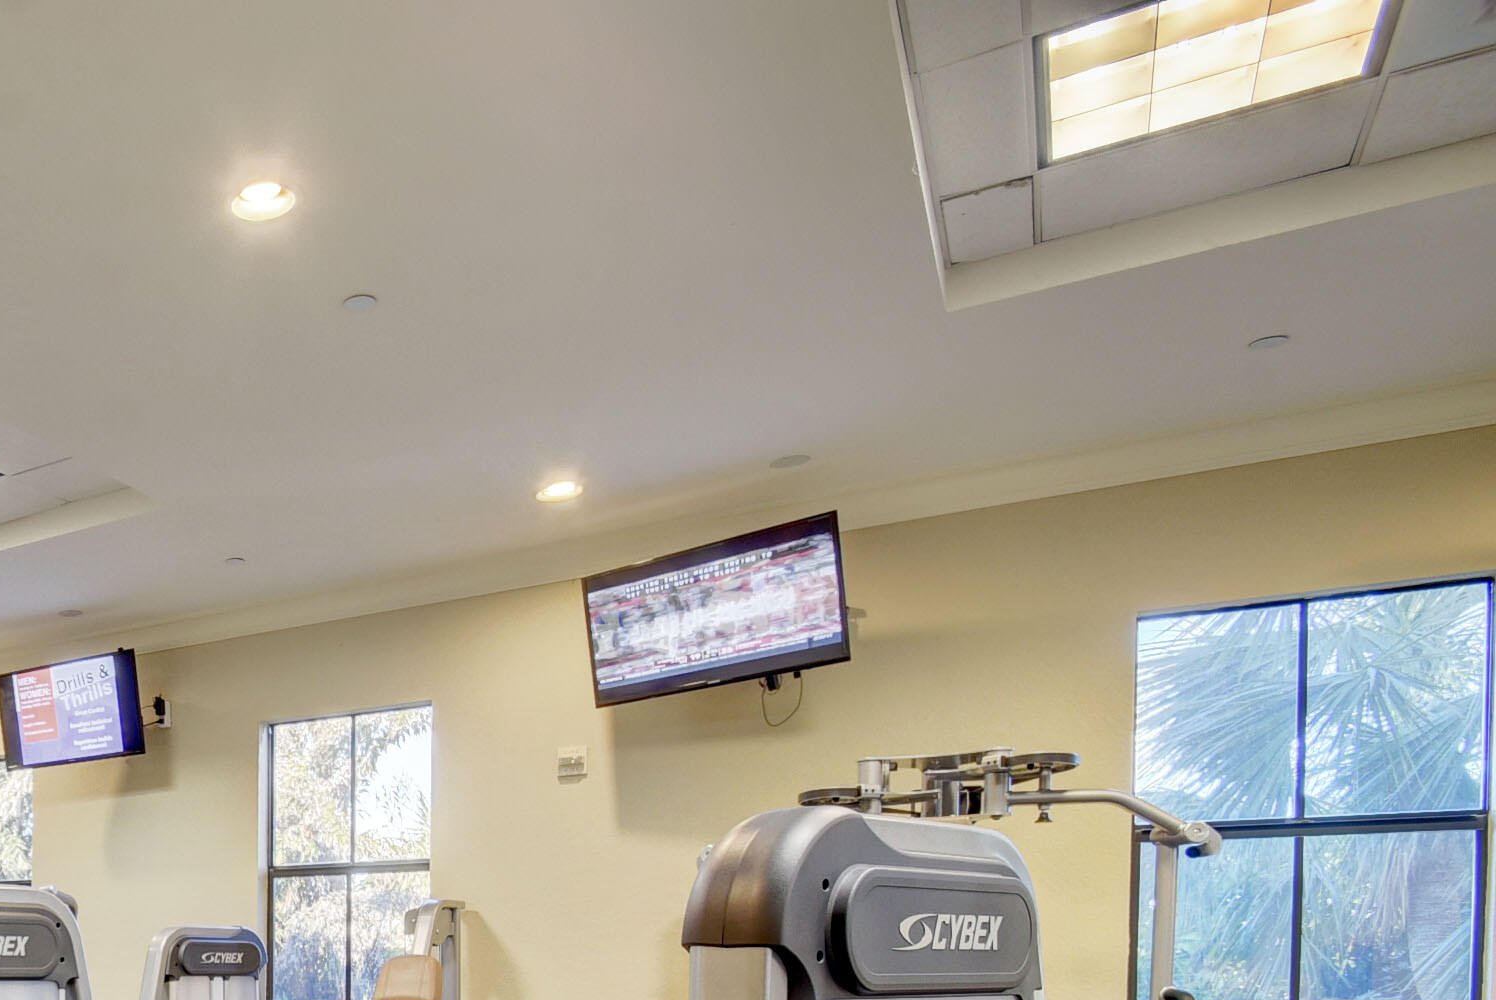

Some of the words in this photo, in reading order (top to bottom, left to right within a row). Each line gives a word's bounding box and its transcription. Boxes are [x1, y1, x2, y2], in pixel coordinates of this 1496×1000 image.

[56, 671, 94, 694] Drills
[98, 664, 109, 679] &
[59, 682, 113, 711] Thrills
[931, 913, 1004, 951] CYBEX
[214, 951, 244, 964] CYBEX
